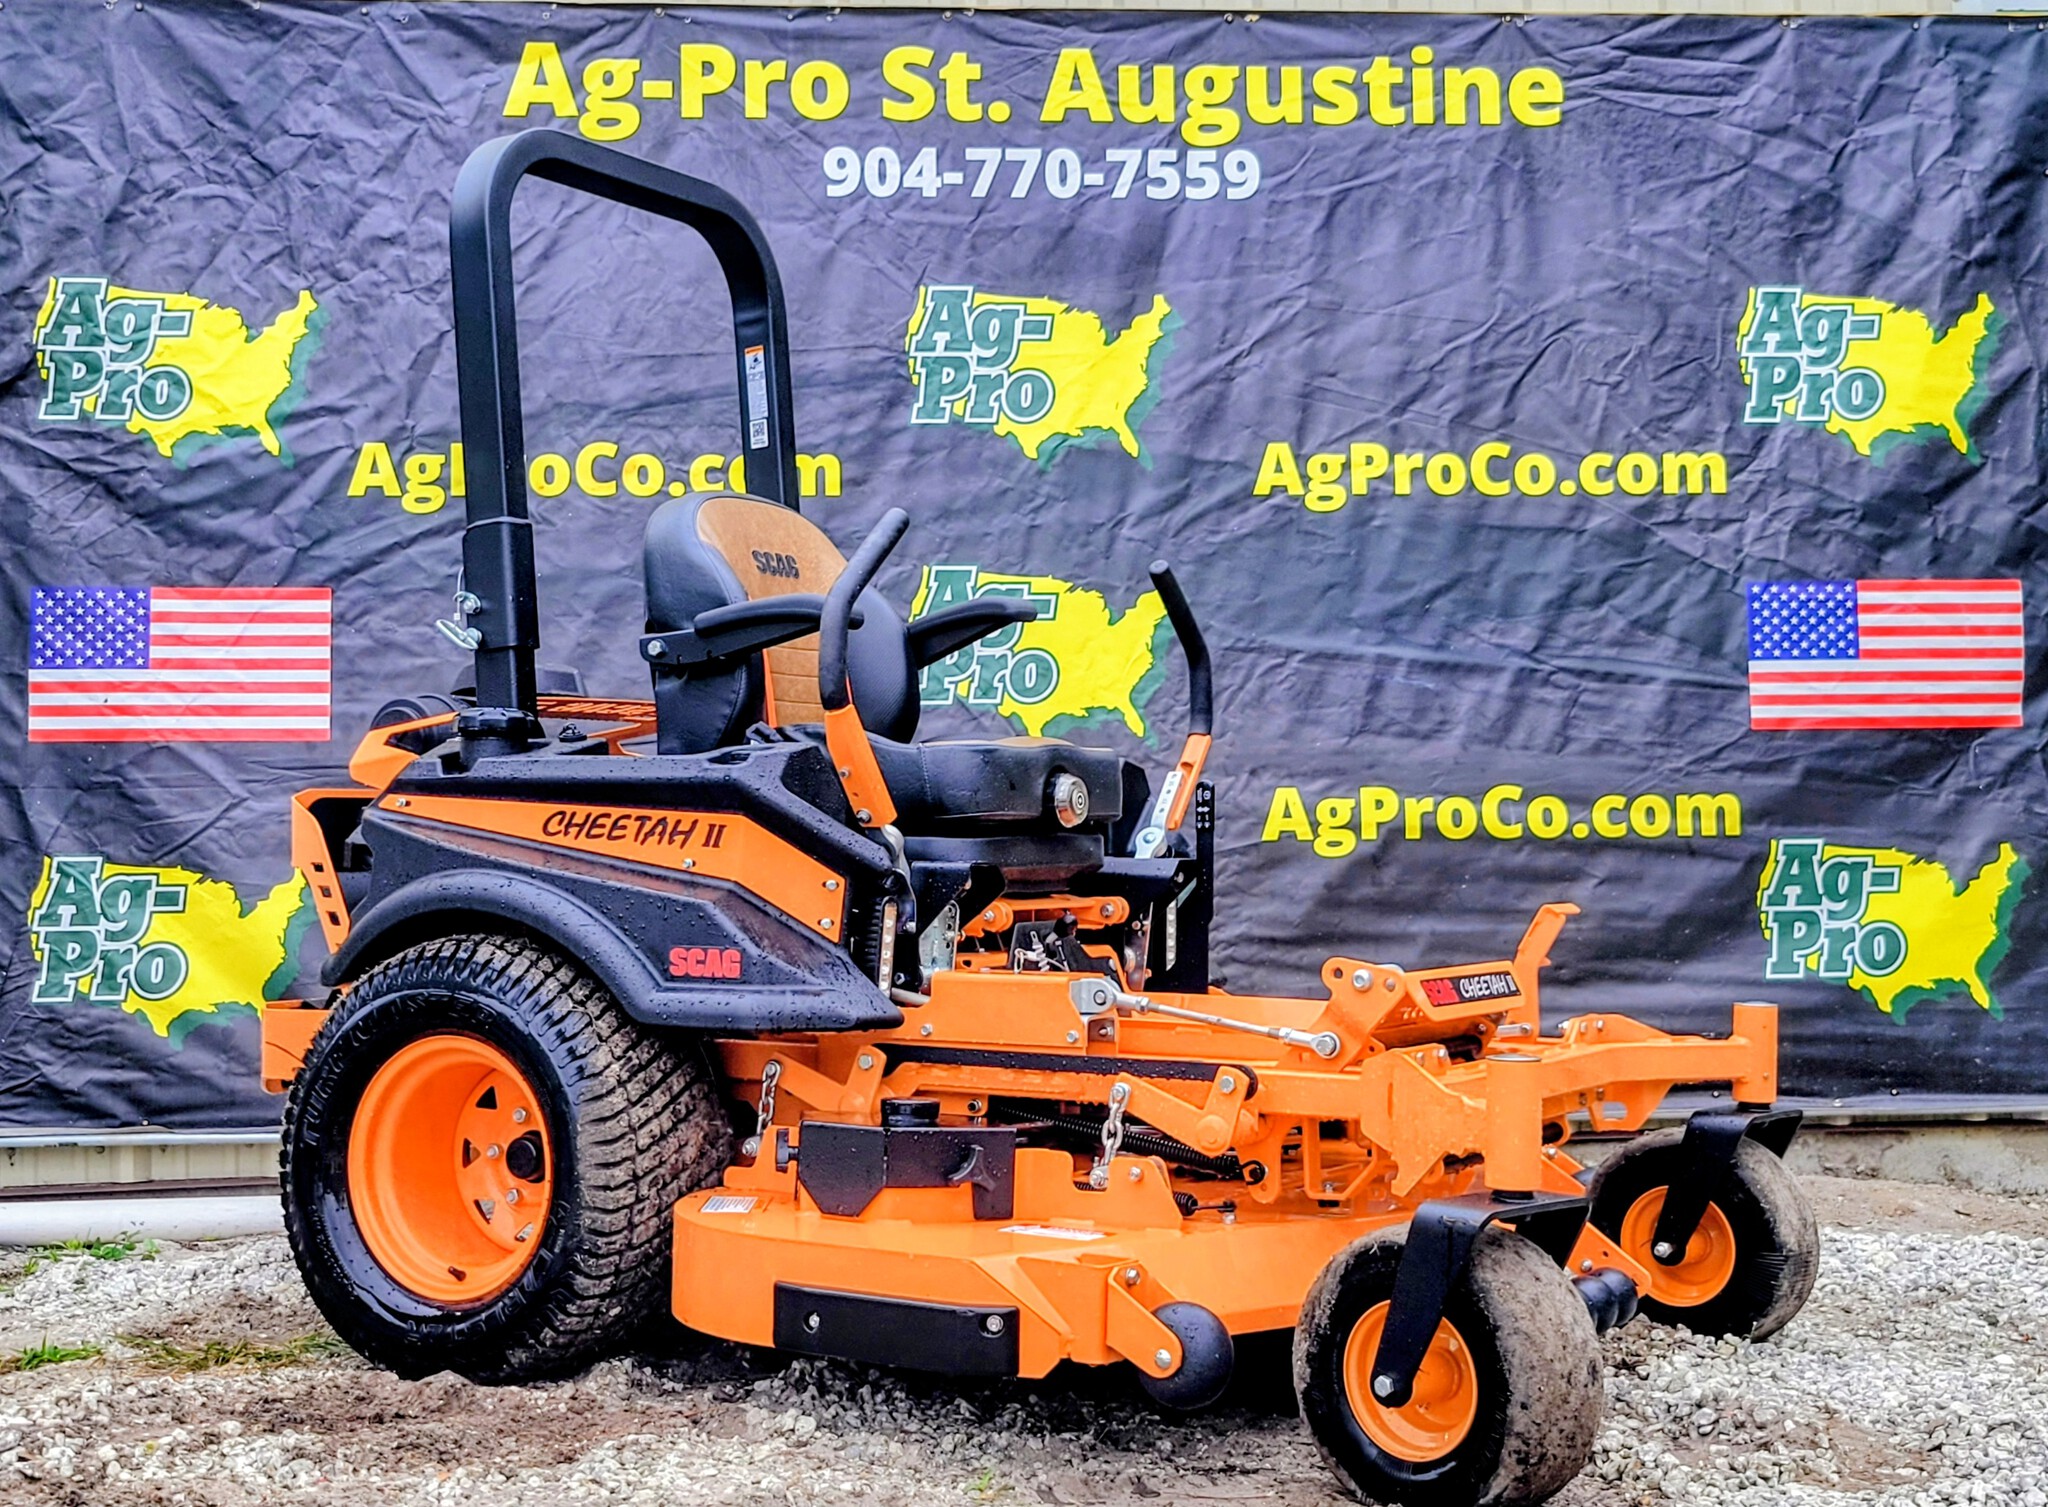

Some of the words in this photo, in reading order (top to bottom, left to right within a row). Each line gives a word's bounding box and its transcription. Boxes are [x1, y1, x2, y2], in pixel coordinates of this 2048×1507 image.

[504, 42, 849, 141] Ag-Pro
[882, 49, 1012, 123] St.
[1040, 47, 1566, 147] Augustine
[822, 145, 1262, 201] 904-770-7559
[37, 277, 192, 366] Ag-
[909, 285, 1053, 371] Ag-
[1741, 288, 1881, 370] Ag-
[38, 350, 191, 421] Pro
[911, 354, 1055, 424] Pro
[1744, 354, 1885, 423] Pro
[348, 442, 841, 515] AgoCo.cm
[1254, 441, 1729, 512] AgProCo.com
[751, 550, 799, 579] SCAG
[542, 810, 699, 850] CHEETAH
[701, 823, 727, 849] II
[1262, 784, 1742, 859] AgProCo.com
[32, 856, 186, 945] Ag-
[1761, 838, 1901, 924] Ag-
[32, 930, 187, 1003] Pro
[669, 947, 742, 979] SCAG
[1765, 908, 1907, 980] Pro
[1460, 974, 1510, 999] CHEETAH
